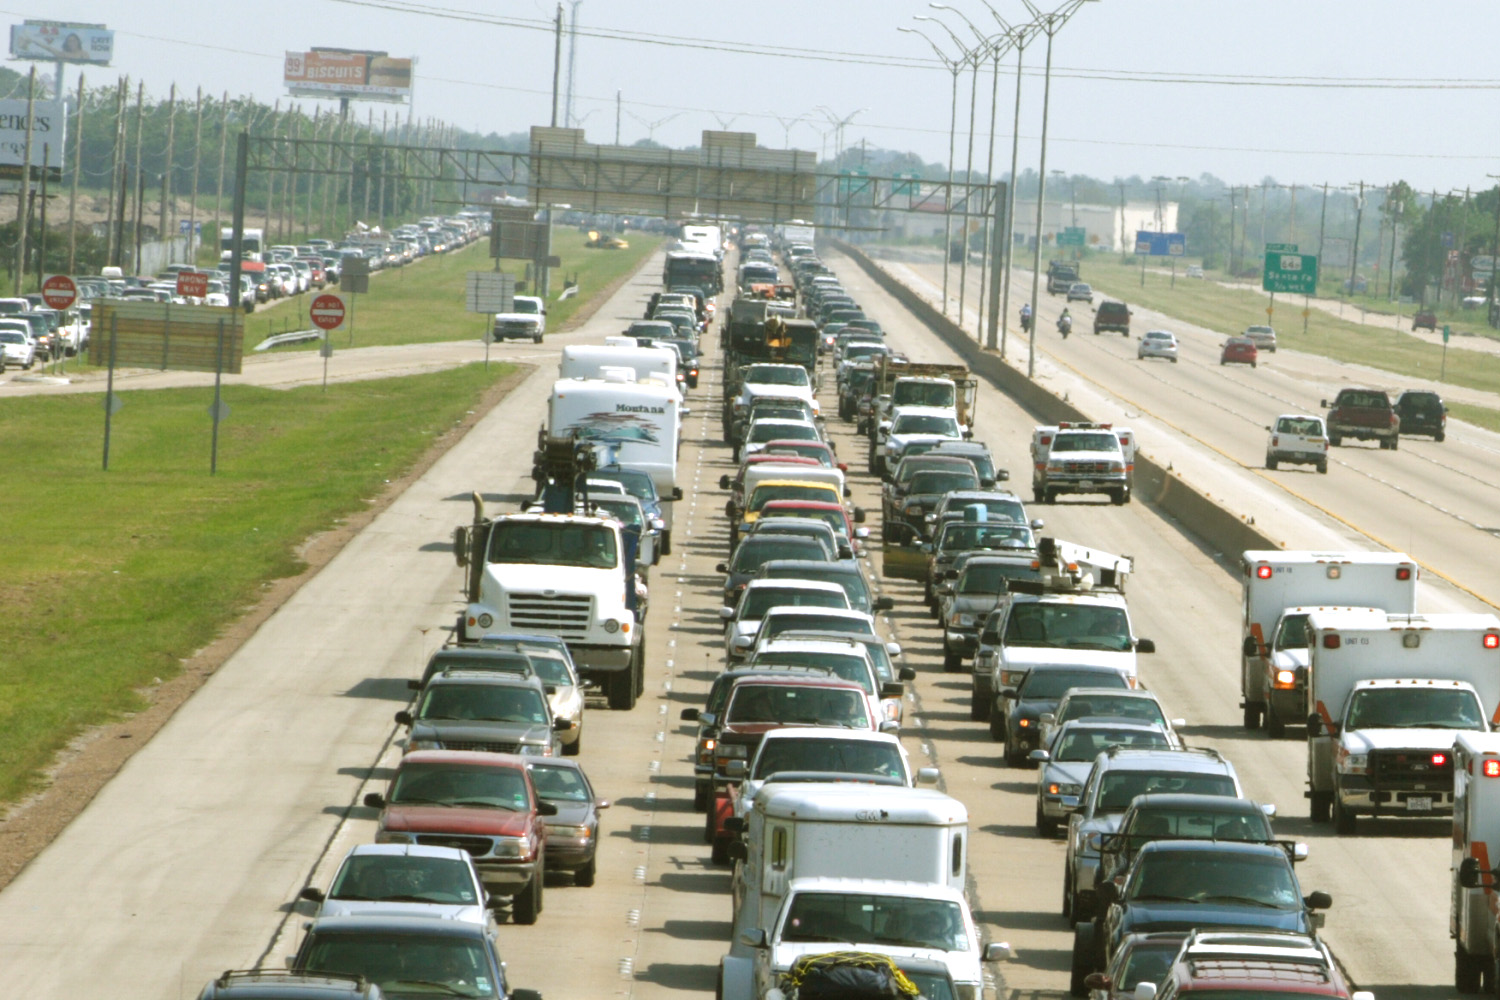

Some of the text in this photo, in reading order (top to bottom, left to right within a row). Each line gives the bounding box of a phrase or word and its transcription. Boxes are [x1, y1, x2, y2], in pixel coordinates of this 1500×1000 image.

[180, 275, 206, 283] WRONG
[183, 285, 200, 293] WAY
[616, 404, 664, 413] Montana
[1345, 637, 1358, 645] UNIT
